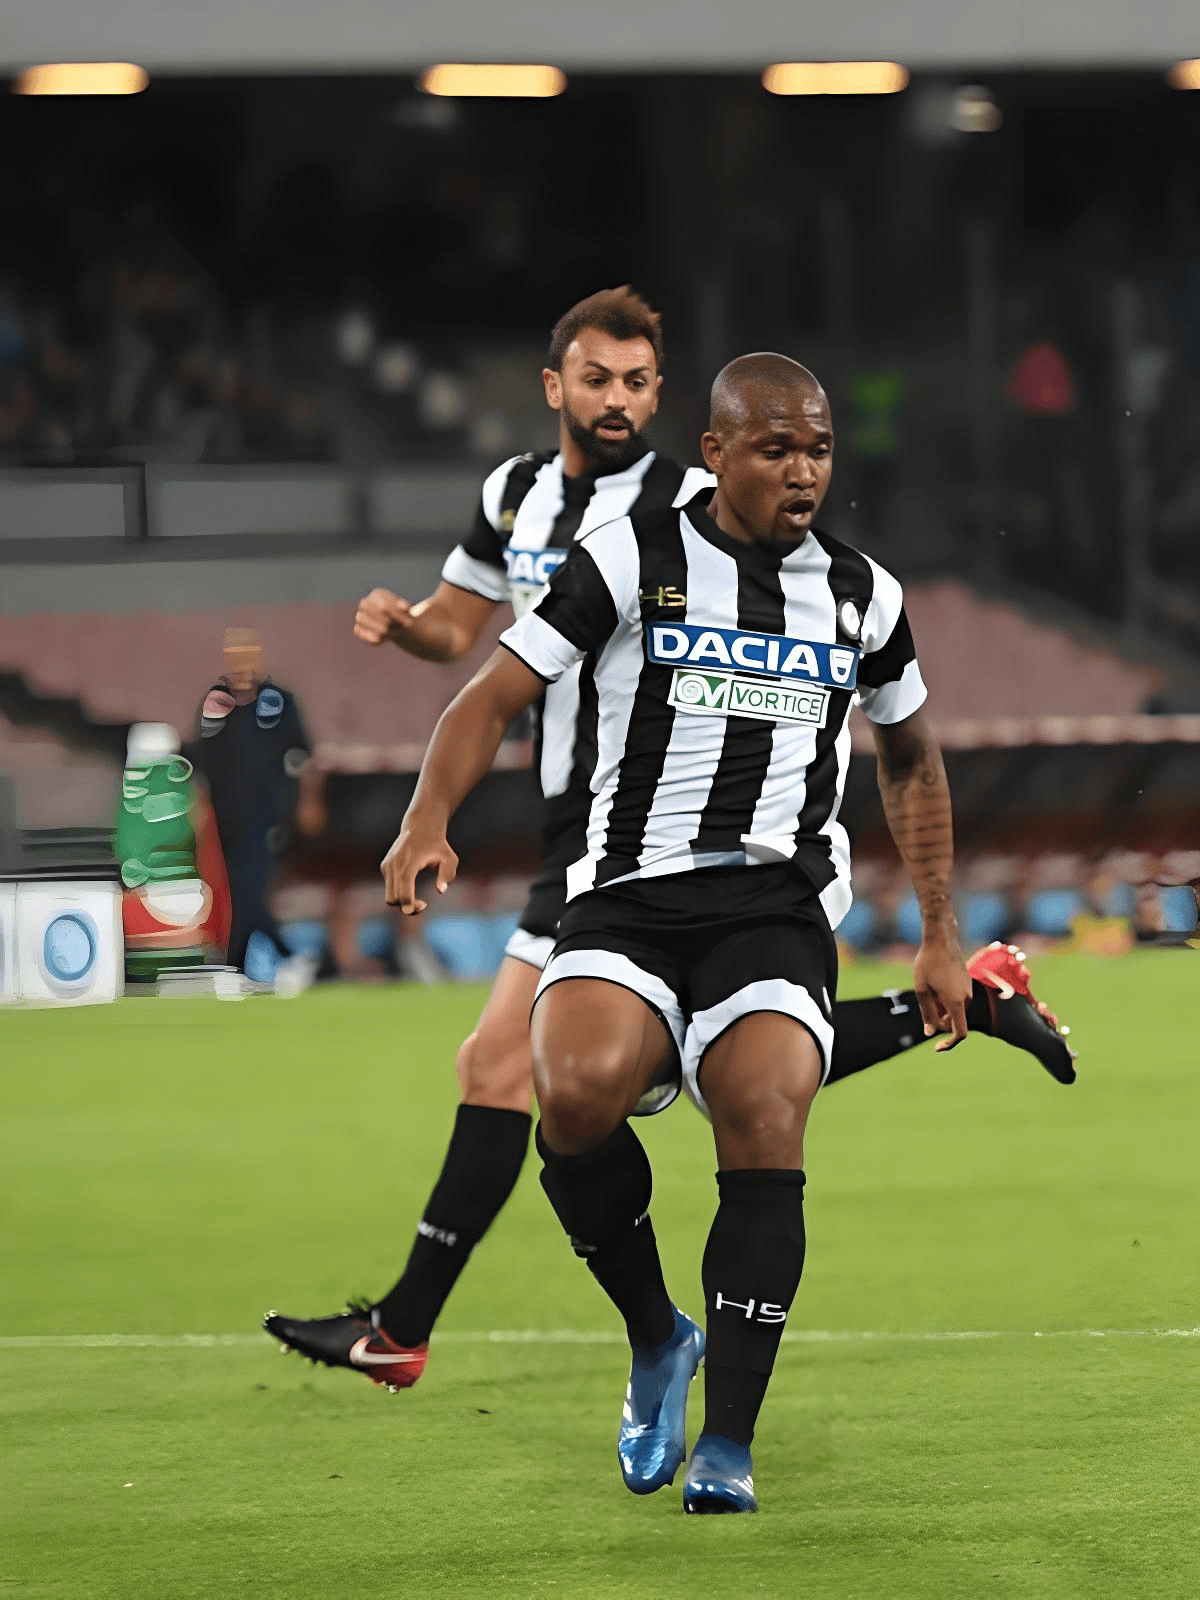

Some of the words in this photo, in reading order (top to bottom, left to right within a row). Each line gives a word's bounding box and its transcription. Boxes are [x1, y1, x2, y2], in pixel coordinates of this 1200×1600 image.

[652, 626, 820, 678] DACIA
[734, 684, 822, 717] VORTICE
[716, 1291, 787, 1323] HS
